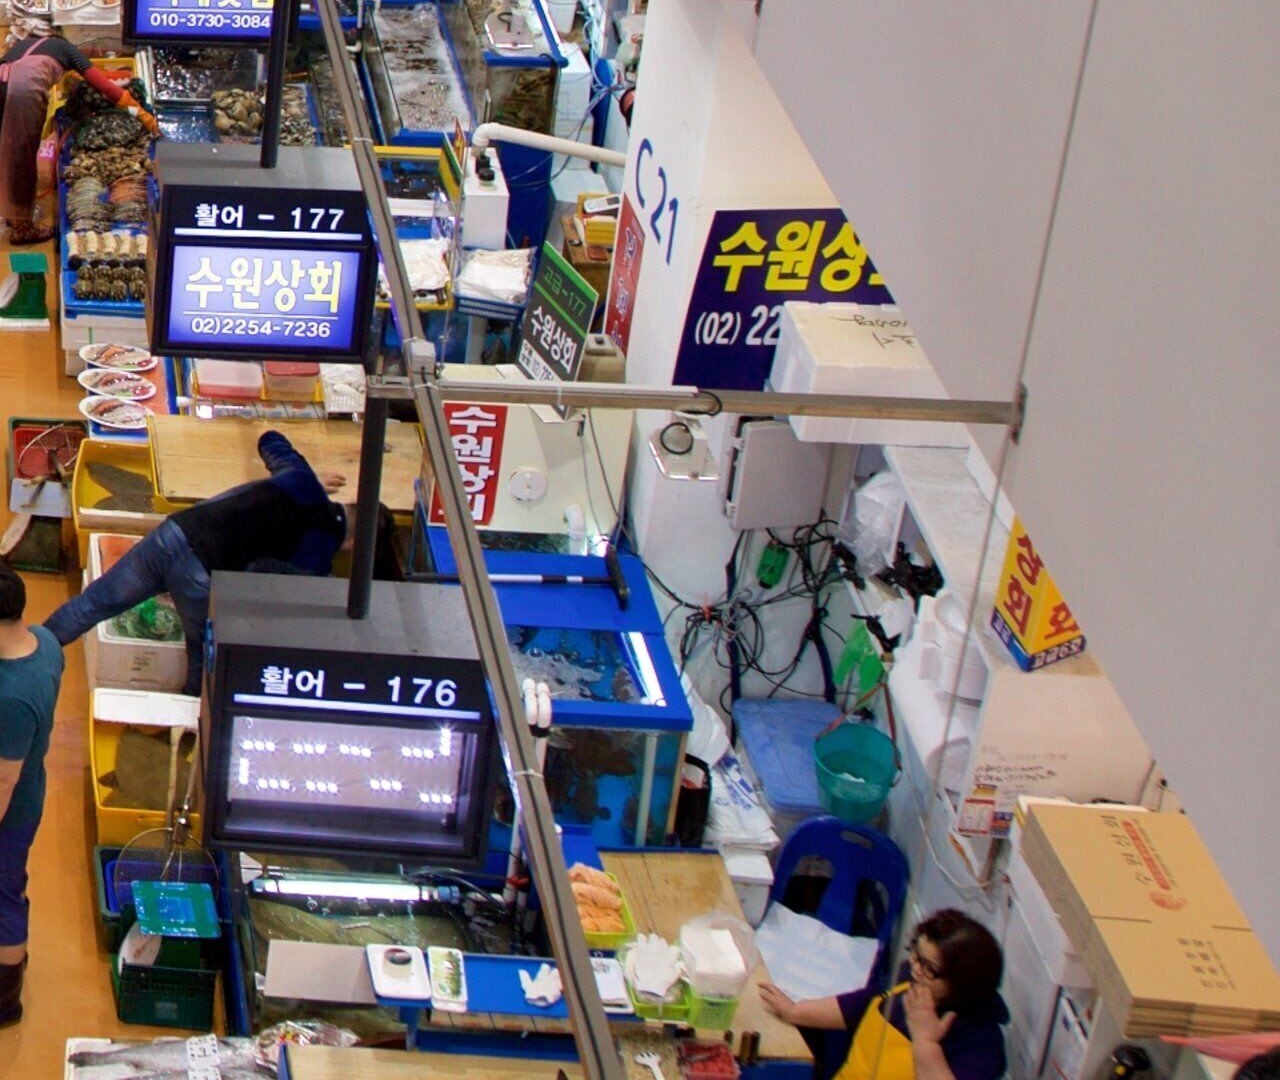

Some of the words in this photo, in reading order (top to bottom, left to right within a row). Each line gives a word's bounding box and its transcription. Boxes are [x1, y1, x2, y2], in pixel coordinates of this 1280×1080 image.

[150, 12, 271, 30] 010-3730-3084
[195, 204, 245, 230] 활어
[291, 207, 345, 231] 177
[636, 138, 678, 266] C21
[713, 220, 886, 293] 수원상
[185, 255, 343, 314] 수원상회
[191, 318, 331, 338] 02)2254-7236
[530, 306, 578, 374] 수원상회
[694, 311, 740, 346] (02)
[261, 665, 325, 697] 활어
[387, 676, 458, 708] 176
